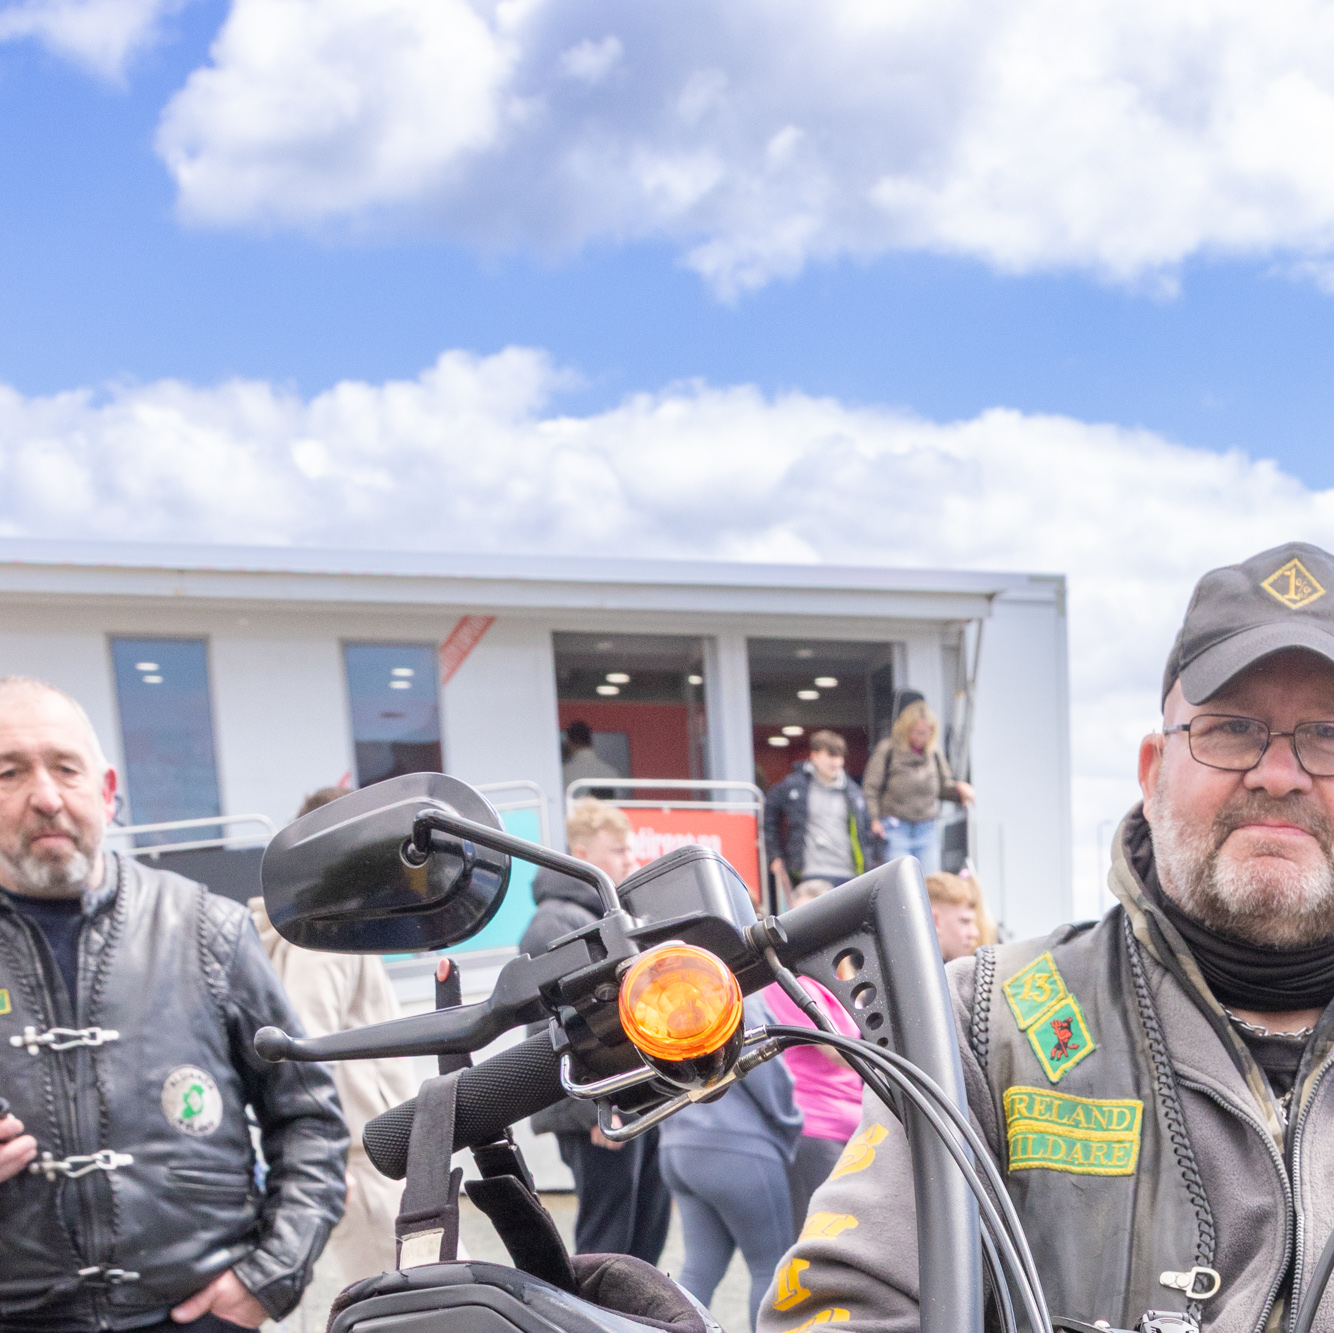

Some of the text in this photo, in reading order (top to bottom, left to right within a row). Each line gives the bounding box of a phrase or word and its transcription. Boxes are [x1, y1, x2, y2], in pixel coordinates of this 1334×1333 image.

[1017, 972, 1051, 1003] 13
[1008, 1094, 1131, 1130] RELAND
[1010, 1134, 1130, 1166] ILDARE
